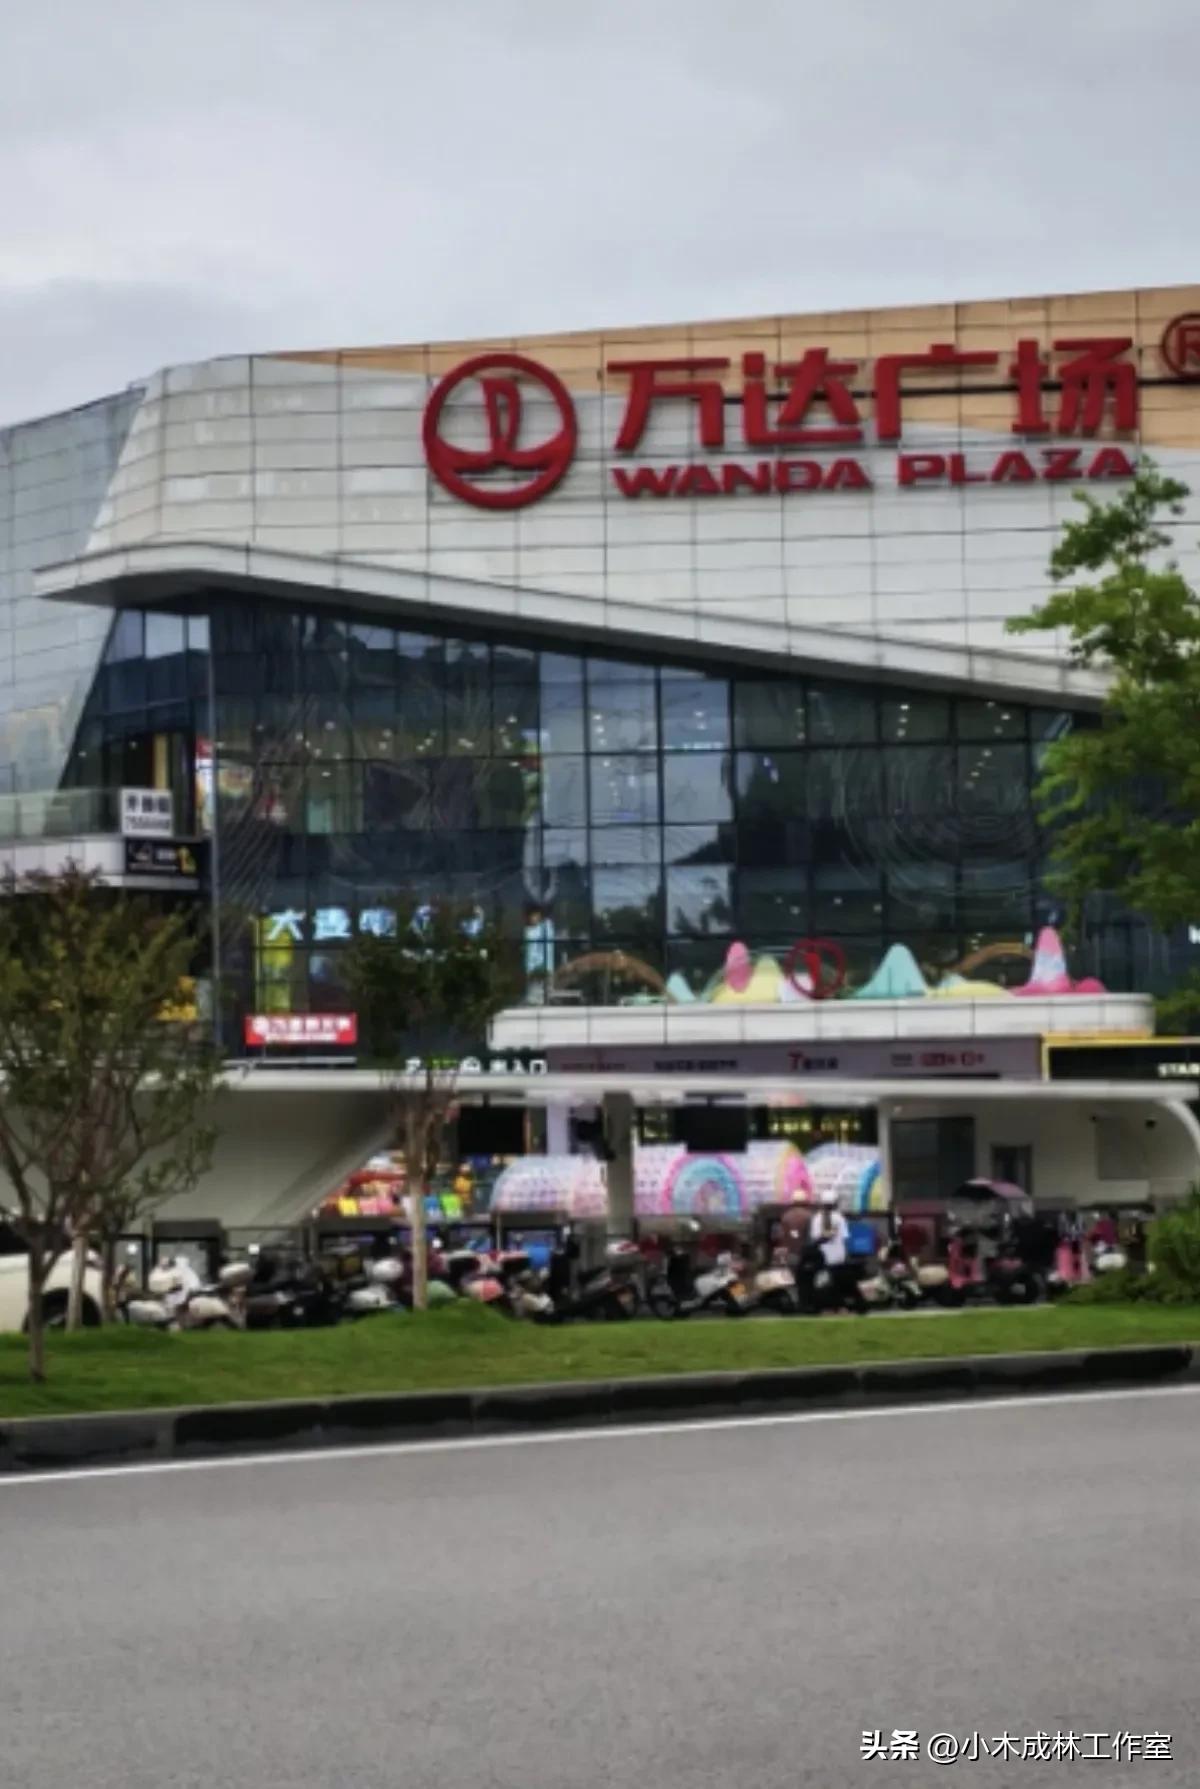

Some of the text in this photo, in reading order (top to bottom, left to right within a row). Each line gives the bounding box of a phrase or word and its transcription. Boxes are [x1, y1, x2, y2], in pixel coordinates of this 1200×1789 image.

[607, 338, 1137, 455] 万达广场
[611, 447, 1136, 498] WANDA PLAZA
